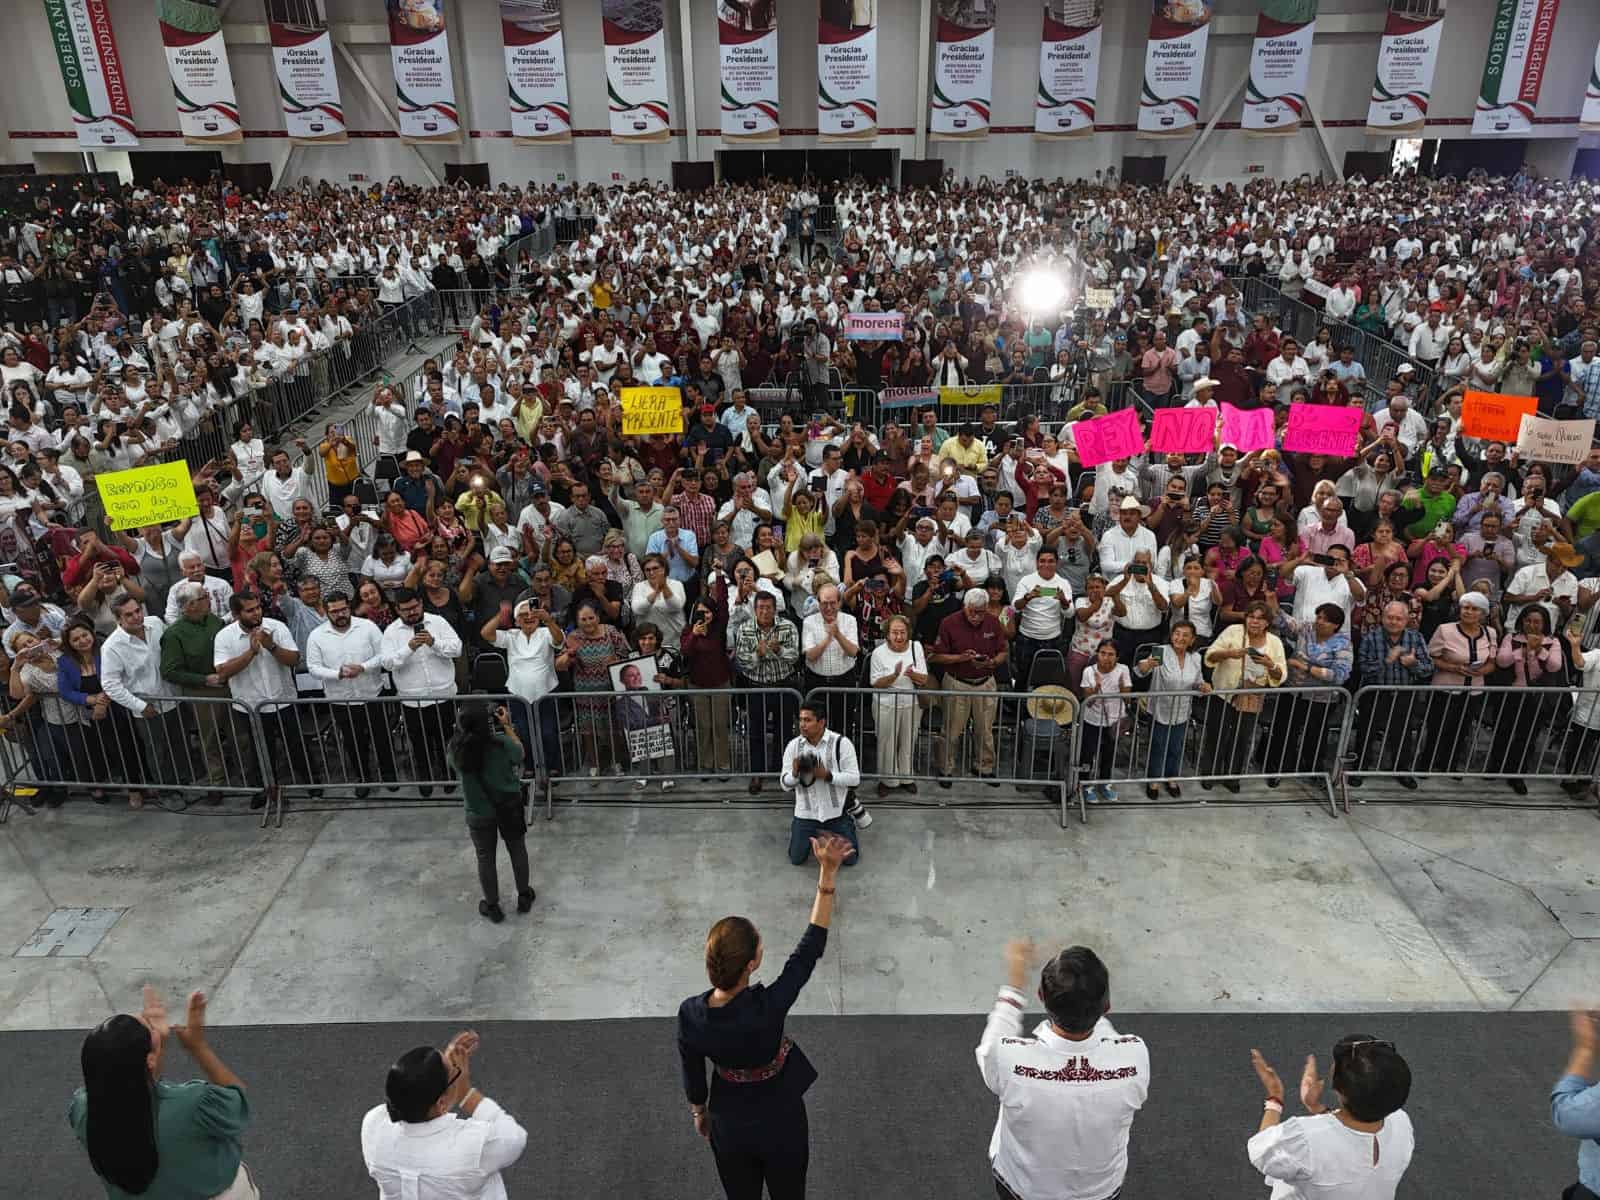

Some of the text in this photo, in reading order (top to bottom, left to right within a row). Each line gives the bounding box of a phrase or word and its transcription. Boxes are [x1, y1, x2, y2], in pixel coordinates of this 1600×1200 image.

[852, 319, 900, 329] morena
[885, 386, 932, 398] morena
[1157, 411, 1213, 450] NO
